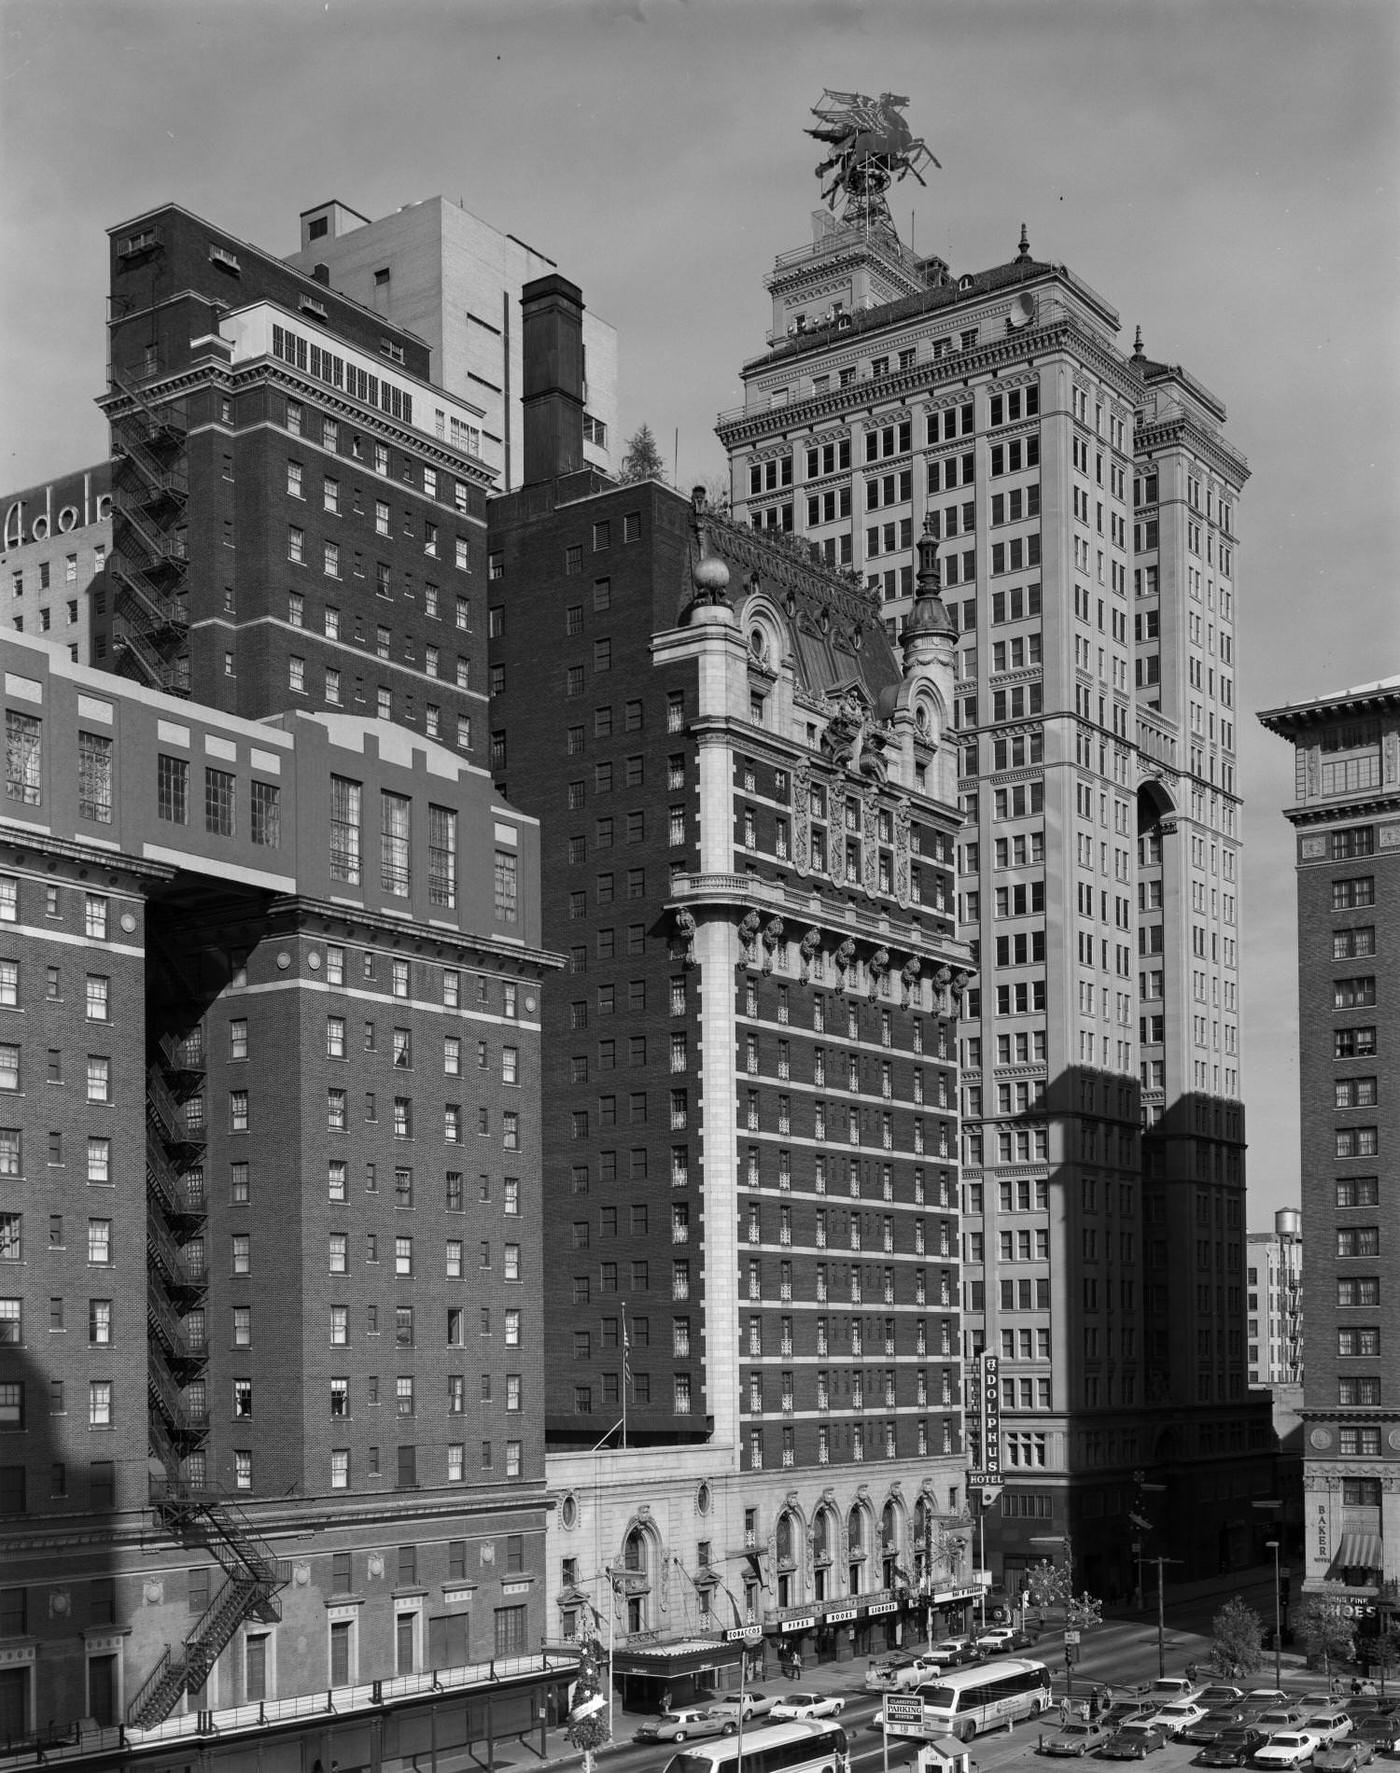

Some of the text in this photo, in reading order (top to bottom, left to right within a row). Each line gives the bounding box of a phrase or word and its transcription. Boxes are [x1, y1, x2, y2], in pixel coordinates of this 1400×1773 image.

[986, 1358, 998, 1473] ADOLPHUS
[970, 1475, 1003, 1484] HOTEL
[1318, 1505, 1327, 1555] BAKER
[832, 1613, 852, 1622] BOOKS
[788, 1620, 809, 1629] PIPES
[729, 1628, 761, 1639] TOBACCOS
[887, 1705, 922, 1714] PARKING
